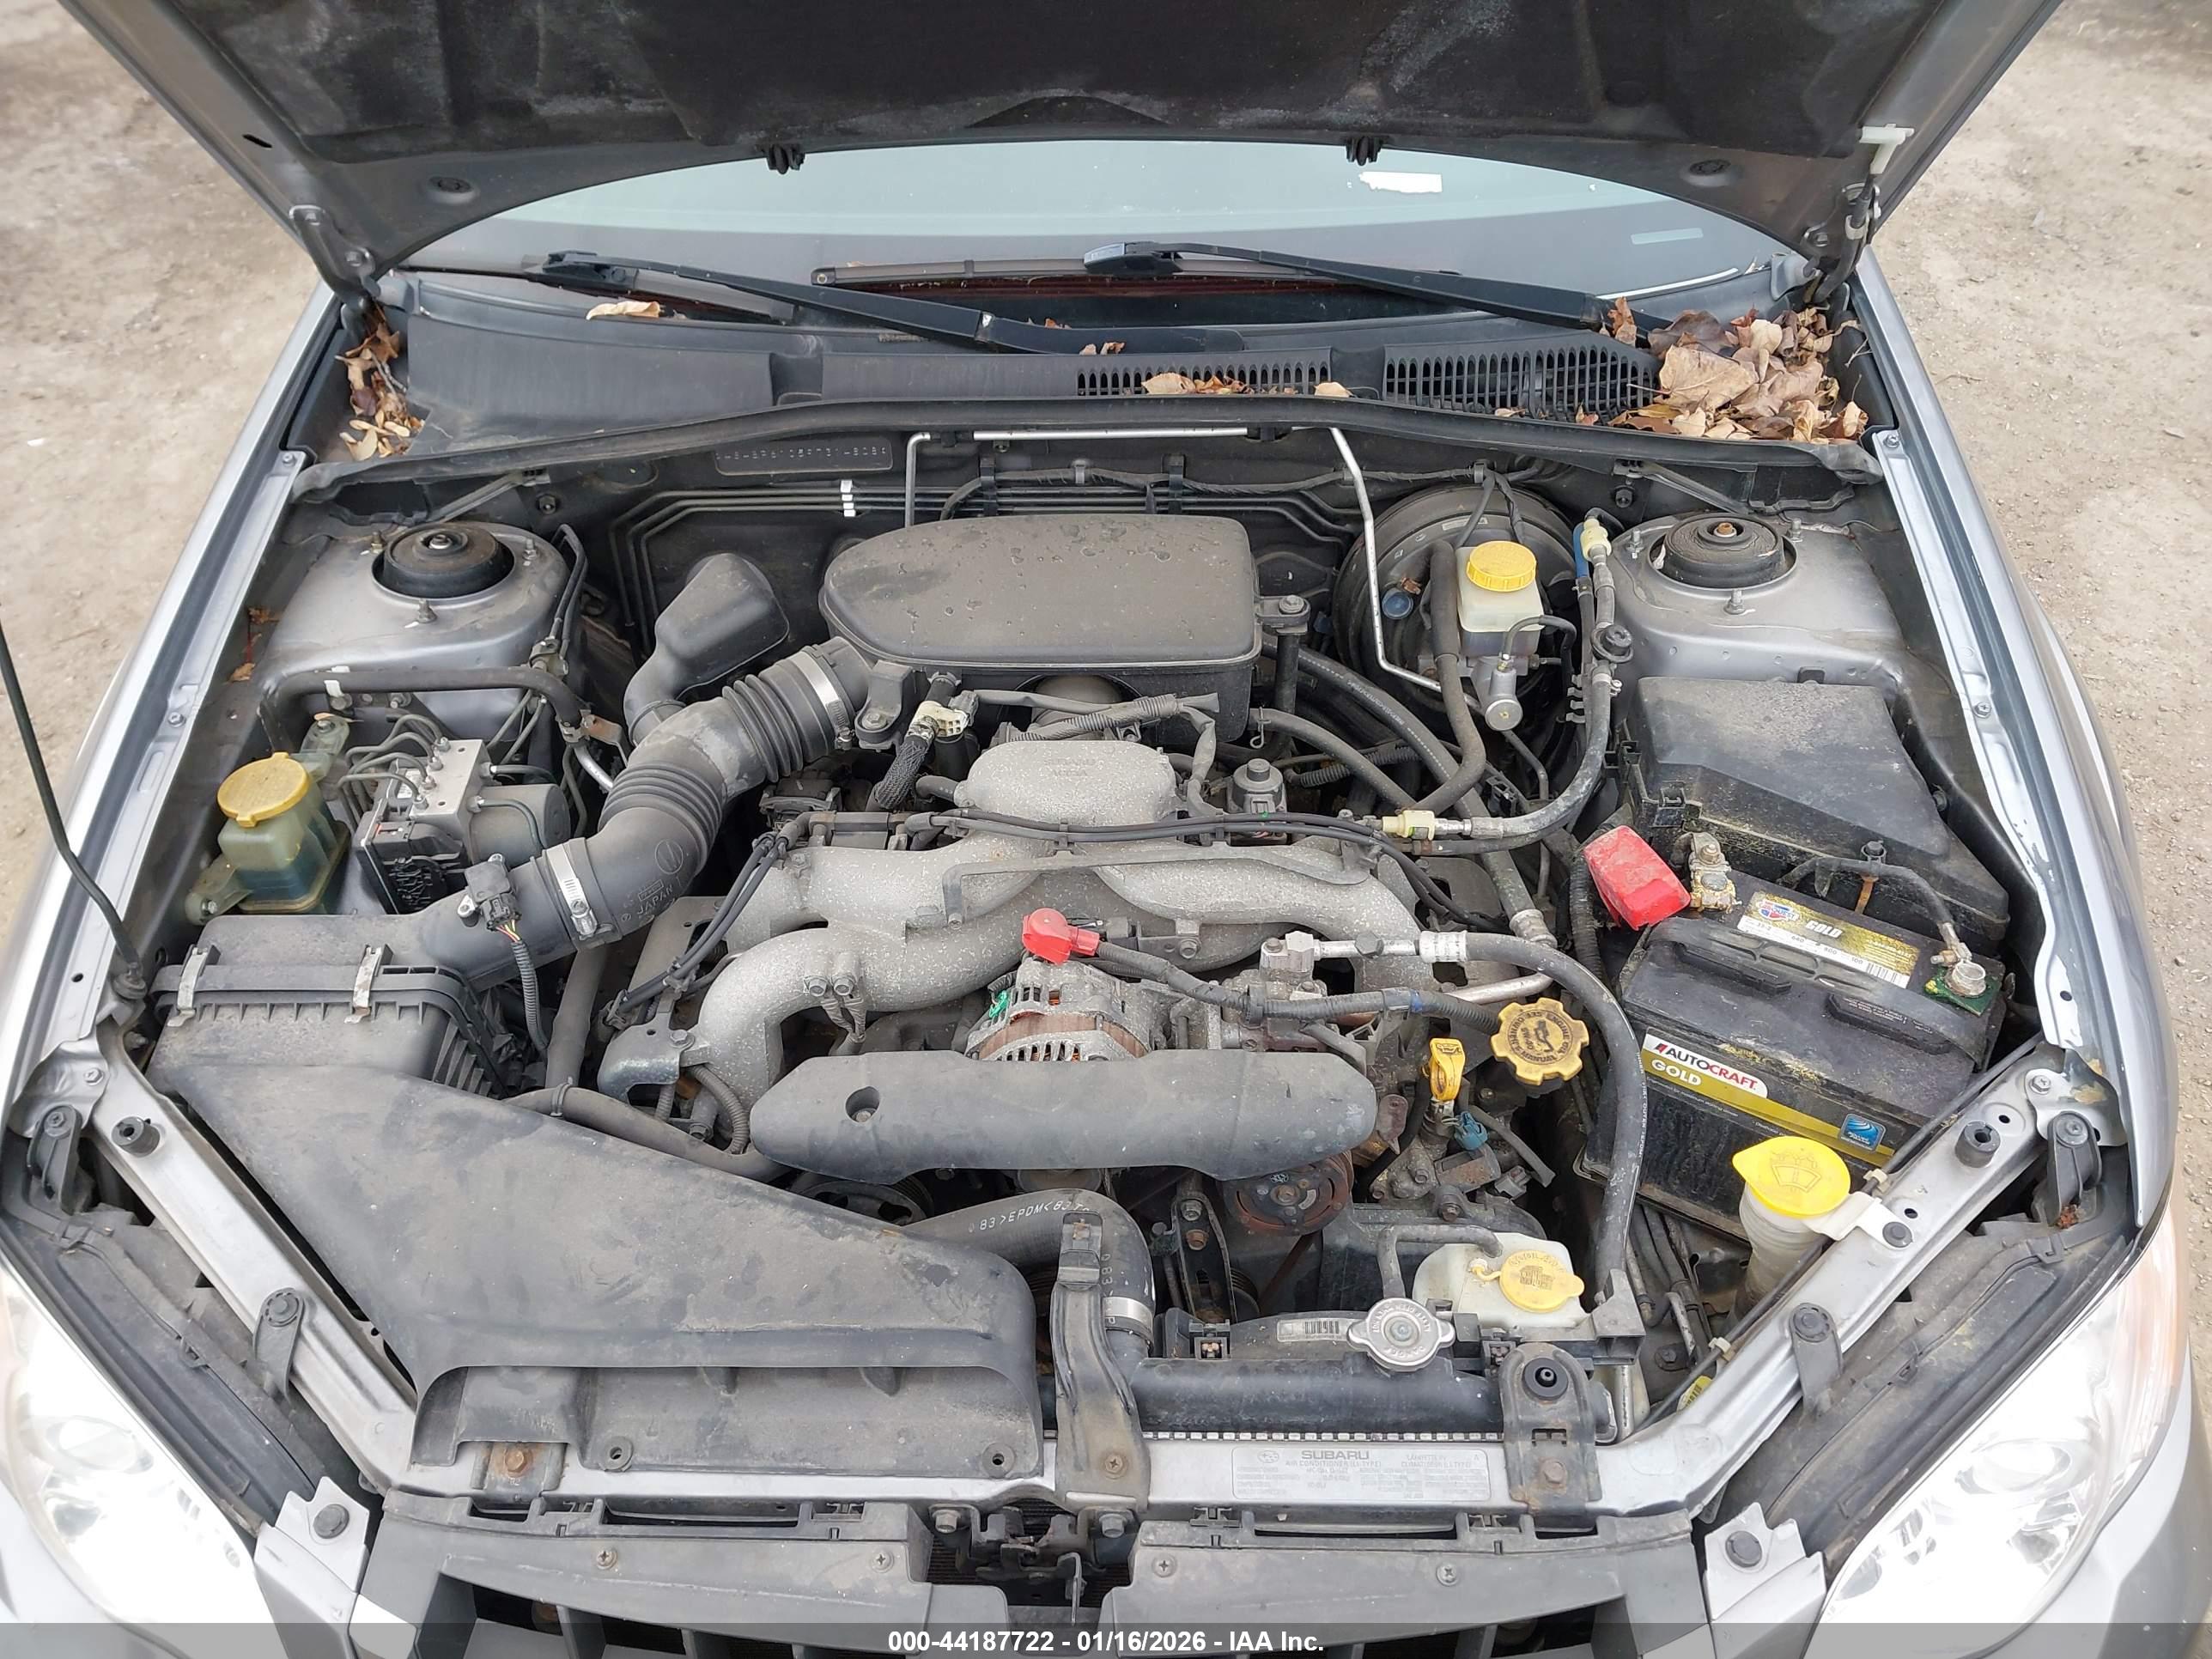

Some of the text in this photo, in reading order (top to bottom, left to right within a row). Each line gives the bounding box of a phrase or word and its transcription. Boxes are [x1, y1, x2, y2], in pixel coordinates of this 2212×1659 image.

[636, 884, 673, 915] JAPAN
[1805, 919, 1844, 939] GOLD
[1651, 1059, 1702, 1086] GOLD
[1664, 1047, 1758, 1090] AUTOCRAFT
[1301, 1449, 1370, 1460] SUBARU
